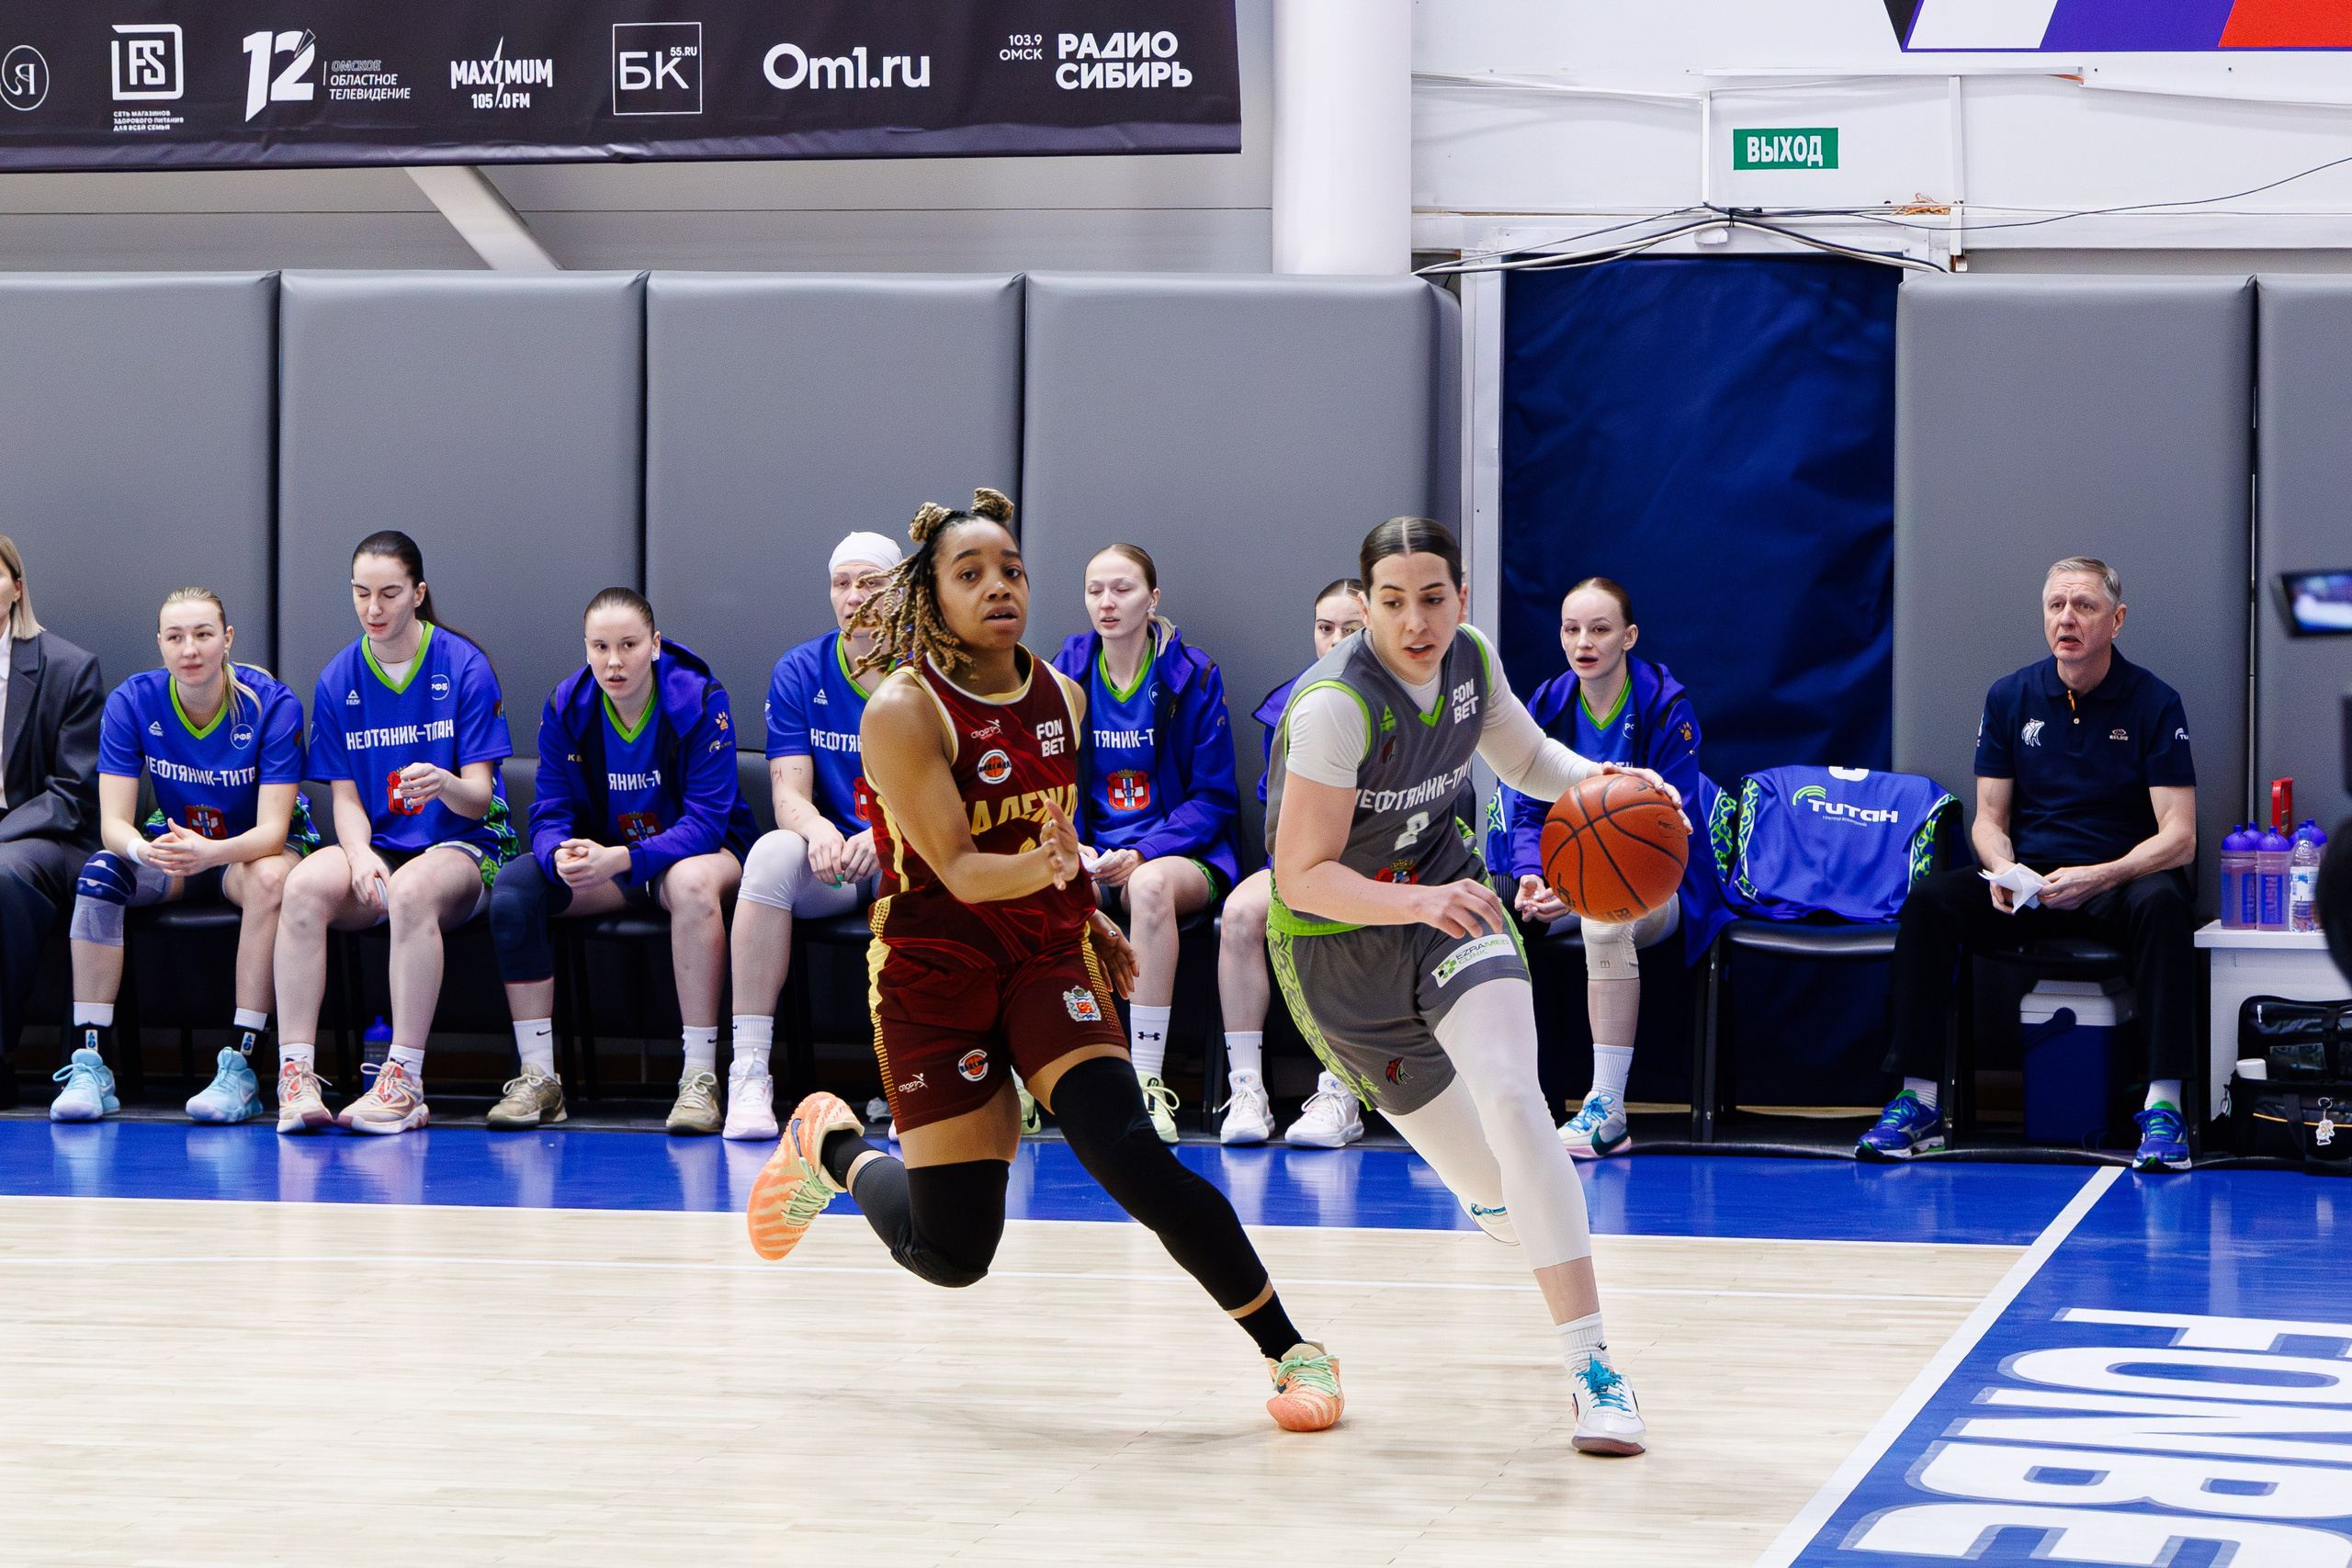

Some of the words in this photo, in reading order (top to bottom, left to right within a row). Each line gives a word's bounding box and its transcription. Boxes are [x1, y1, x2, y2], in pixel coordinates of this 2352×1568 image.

[1008, 34, 1043, 46] 103.9
[1057, 30, 1179, 59] РАДИО
[670, 46, 697, 57] 55.RU
[999, 48, 1043, 61] ОМСК
[243, 30, 316, 122] 12
[450, 59, 553, 89] MAXIMUM
[619, 51, 690, 90] БК
[763, 42, 931, 90] Om1.ru
[1056, 62, 1193, 90] СИБИРЬ
[330, 73, 399, 86] ОБЛАСТНОЕ
[329, 87, 412, 101] ТЕЛЕВИДЕНИЕ
[513, 93, 530, 108] FM
[1747, 135, 1823, 166] ВЫХОД
[1452, 678, 1475, 707] FON
[1453, 695, 1479, 725] BET
[1035, 718, 1064, 740] FON
[1041, 736, 1066, 758] BET
[1456, 939, 1510, 961] EZRAMED
[1458, 948, 1488, 965] CLINIC
